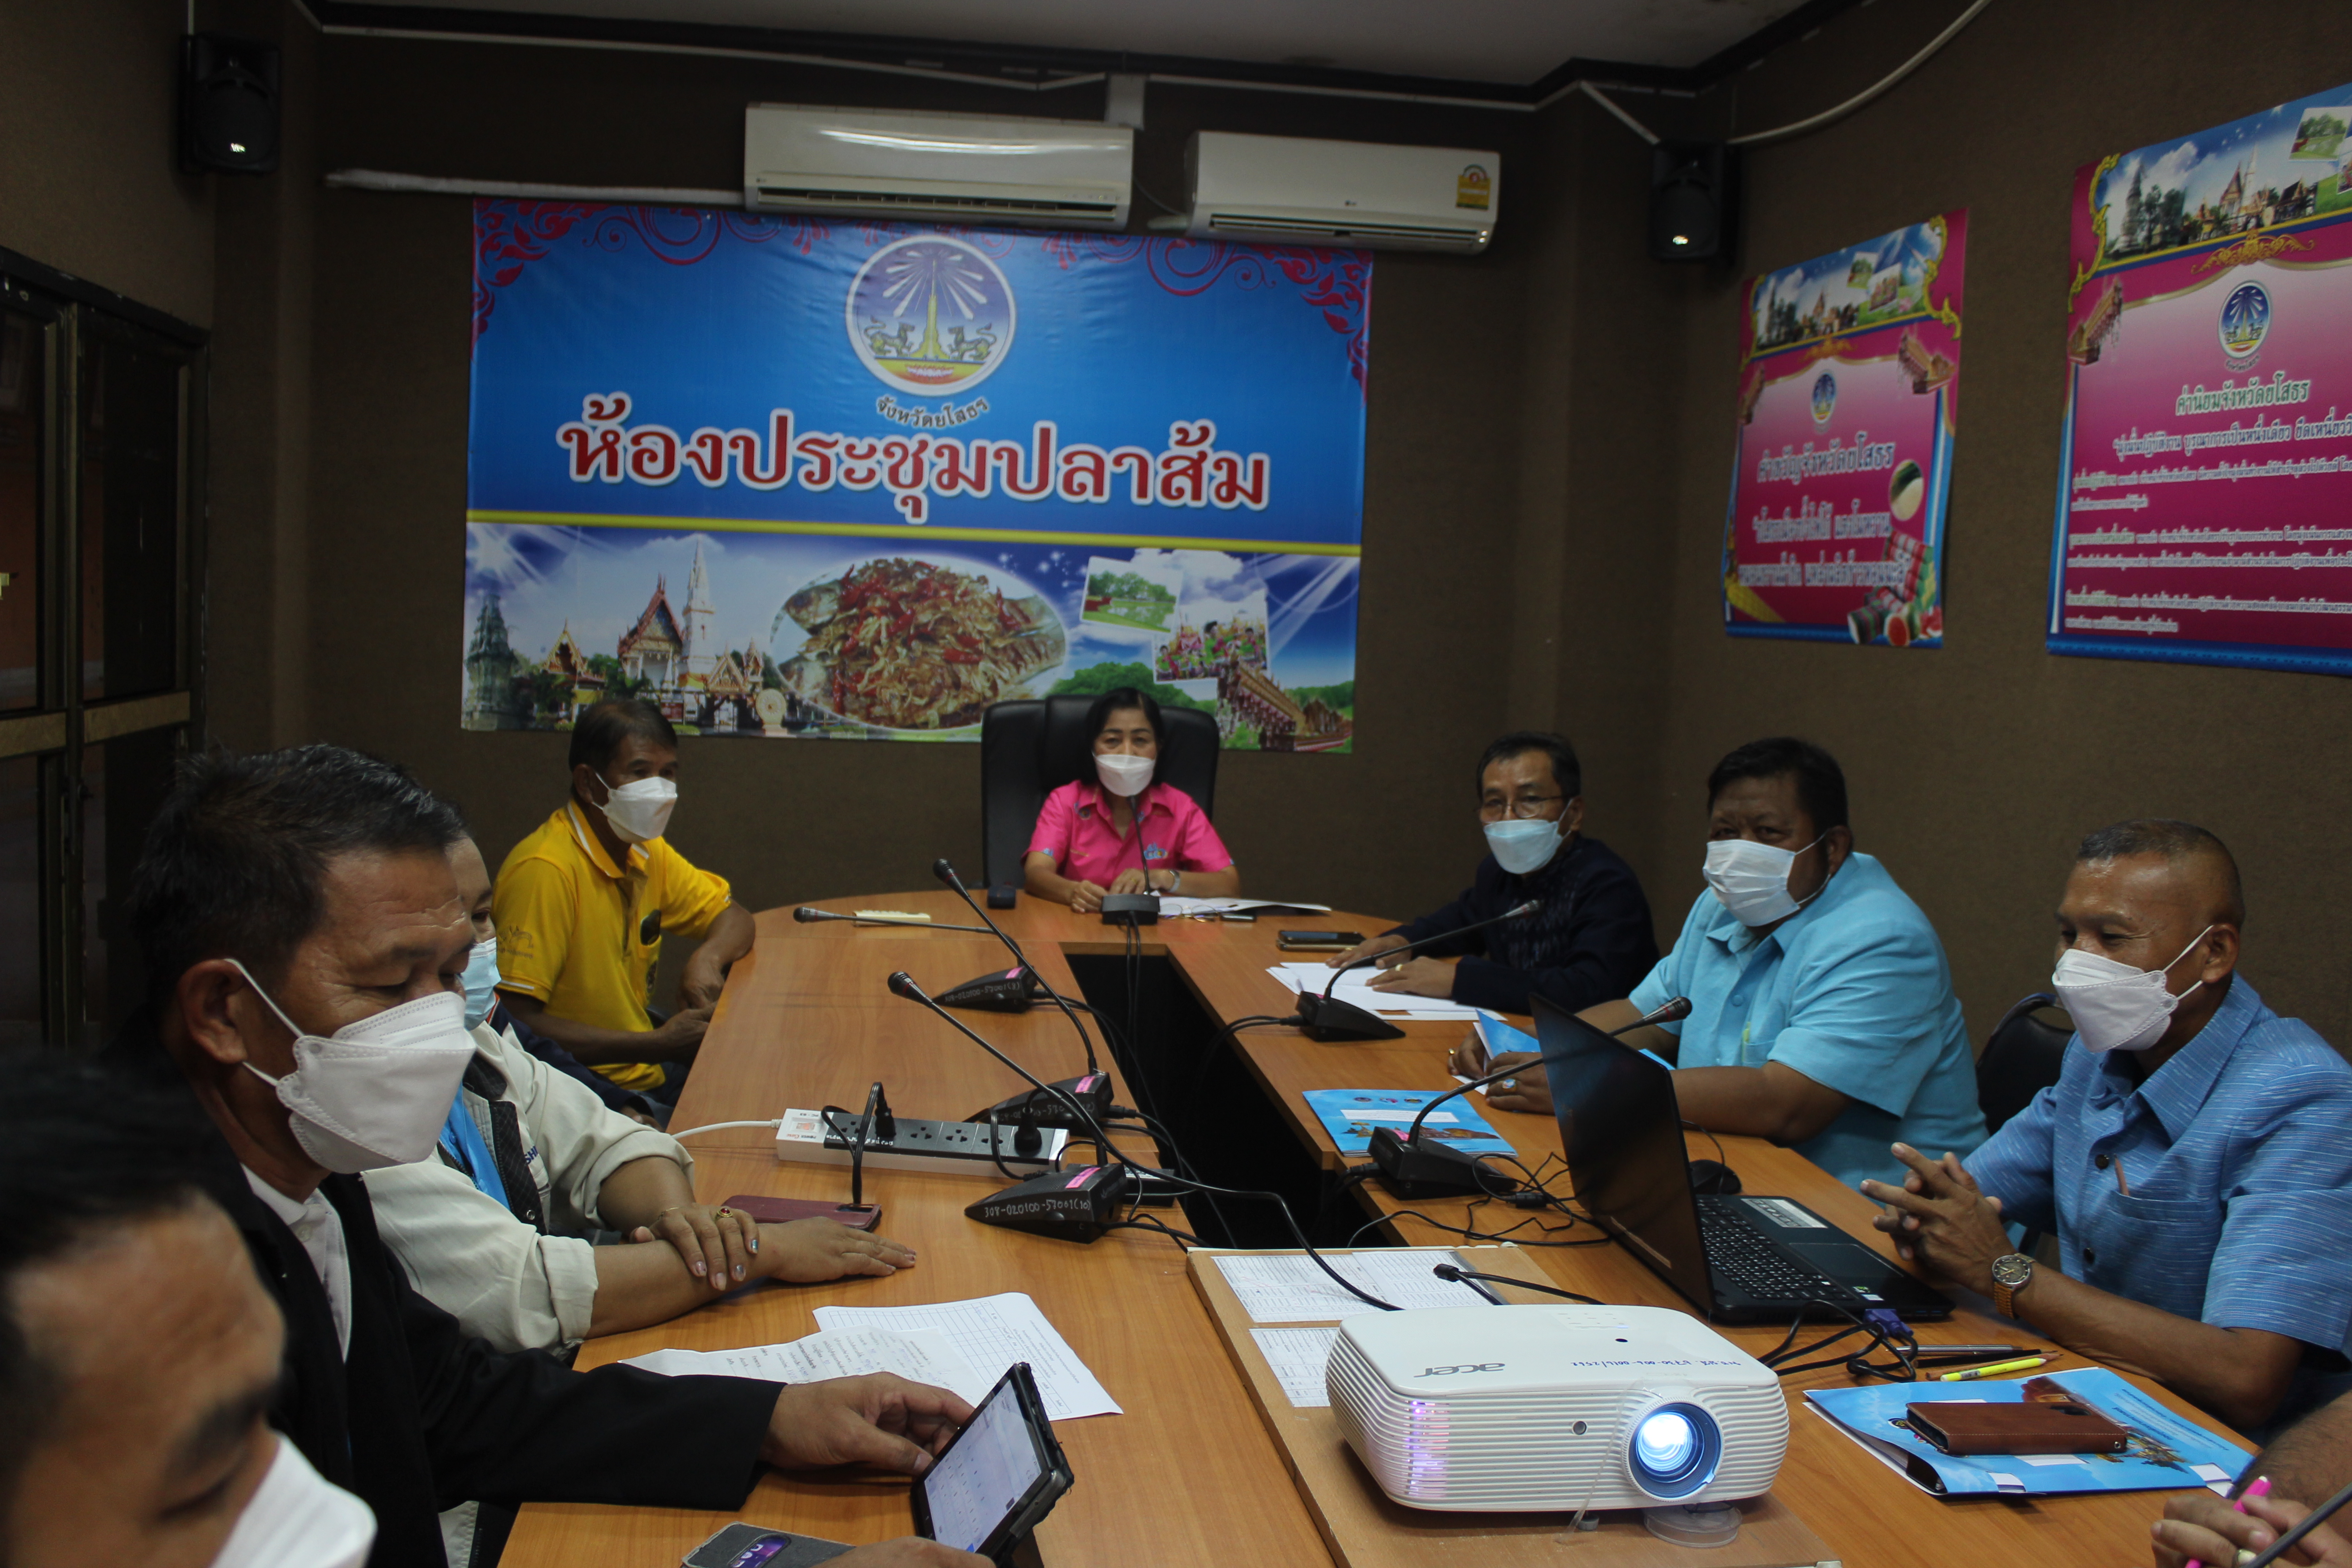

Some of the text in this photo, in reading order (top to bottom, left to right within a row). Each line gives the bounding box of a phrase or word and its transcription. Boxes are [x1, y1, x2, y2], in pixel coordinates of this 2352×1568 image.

[874, 395, 990, 429] จังหวัดยโสธร
[2176, 370, 2311, 416] ค่านิยมจังหวัดยโสธร
[556, 392, 1270, 524] ห้องประชุมปลาส้ม
[1413, 1362, 1506, 1378] acer
